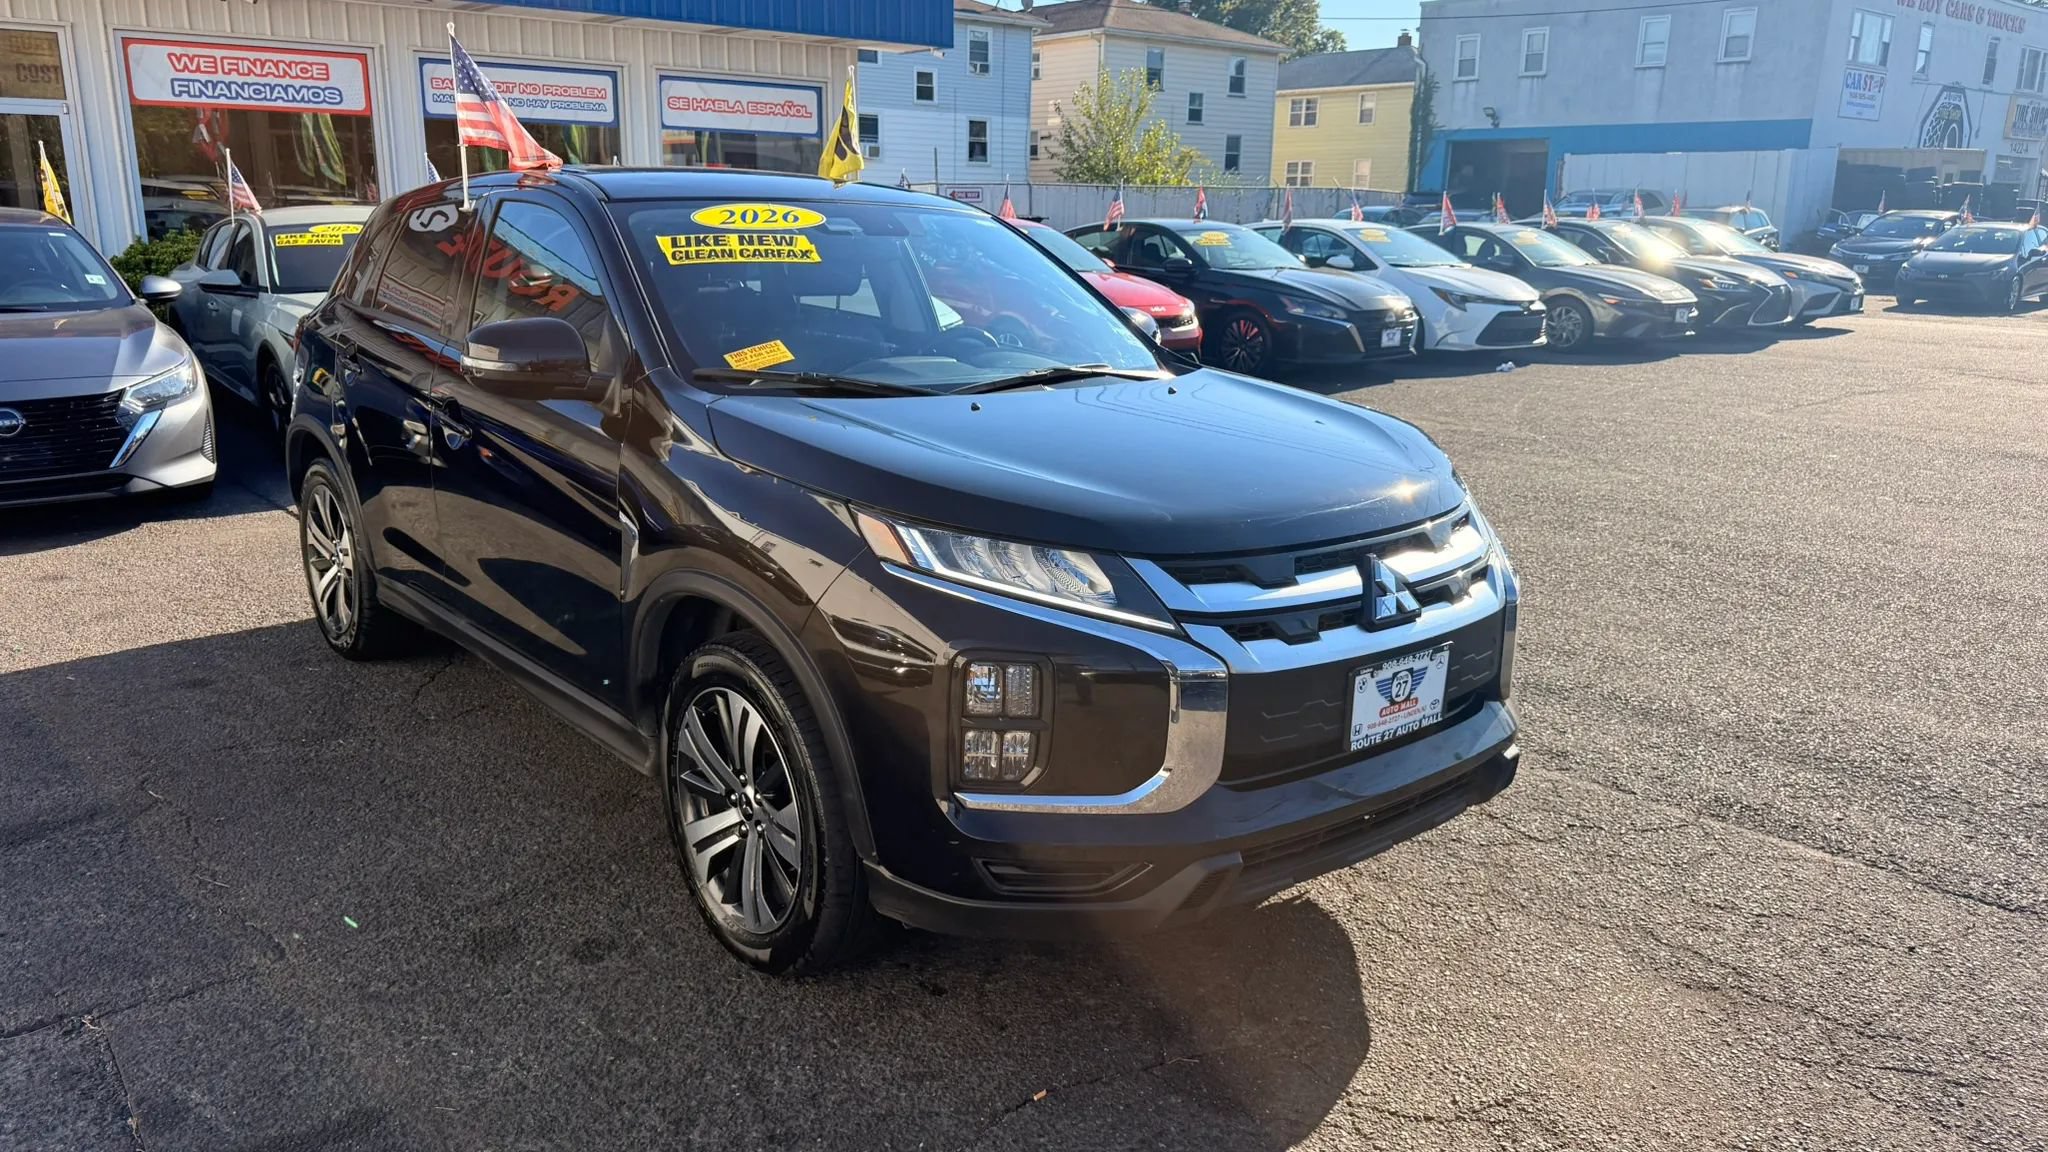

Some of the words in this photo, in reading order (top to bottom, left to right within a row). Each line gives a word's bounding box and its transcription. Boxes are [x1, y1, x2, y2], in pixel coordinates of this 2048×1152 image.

[1945, 0, 1975, 22] CARS
[1987, 8, 2026, 33] TRUCKS
[16, 62, 60, 85] COST
[168, 53, 217, 73] WE
[221, 56, 329, 81] FINANCE
[431, 77, 455, 90] BA
[519, 83, 540, 96] NO
[543, 85, 607, 99] PROBLEM
[1845, 71, 1862, 90] CAR
[171, 78, 342, 105] FINANCIAMOS
[508, 98, 524, 107] NO
[526, 99, 549, 109] HAY
[551, 100, 607, 112] PROBLEMA
[668, 96, 690, 110] SE
[692, 98, 745, 113] HABLA
[747, 101, 812, 118] ESPAÑOL
[2014, 104, 2030, 122] TIRE
[719, 208, 800, 225] 2026
[670, 235, 730, 249] LIKE
[738, 235, 797, 248] NEW
[671, 248, 734, 261] CLEAN
[739, 248, 813, 259] CARFAX
[728, 351, 748, 360] THIS
[747, 342, 779, 354] VEHICLE
[765, 347, 781, 355] SALE
[1395, 680, 1409, 698] 27
[1381, 705, 1399, 716] AUTO
[1400, 698, 1416, 710] MALL
[1350, 735, 1381, 751] ROUTE
[1383, 729, 1394, 740] 27
[1396, 722, 1419, 737] AUTO
[1421, 713, 1443, 728] MALL
